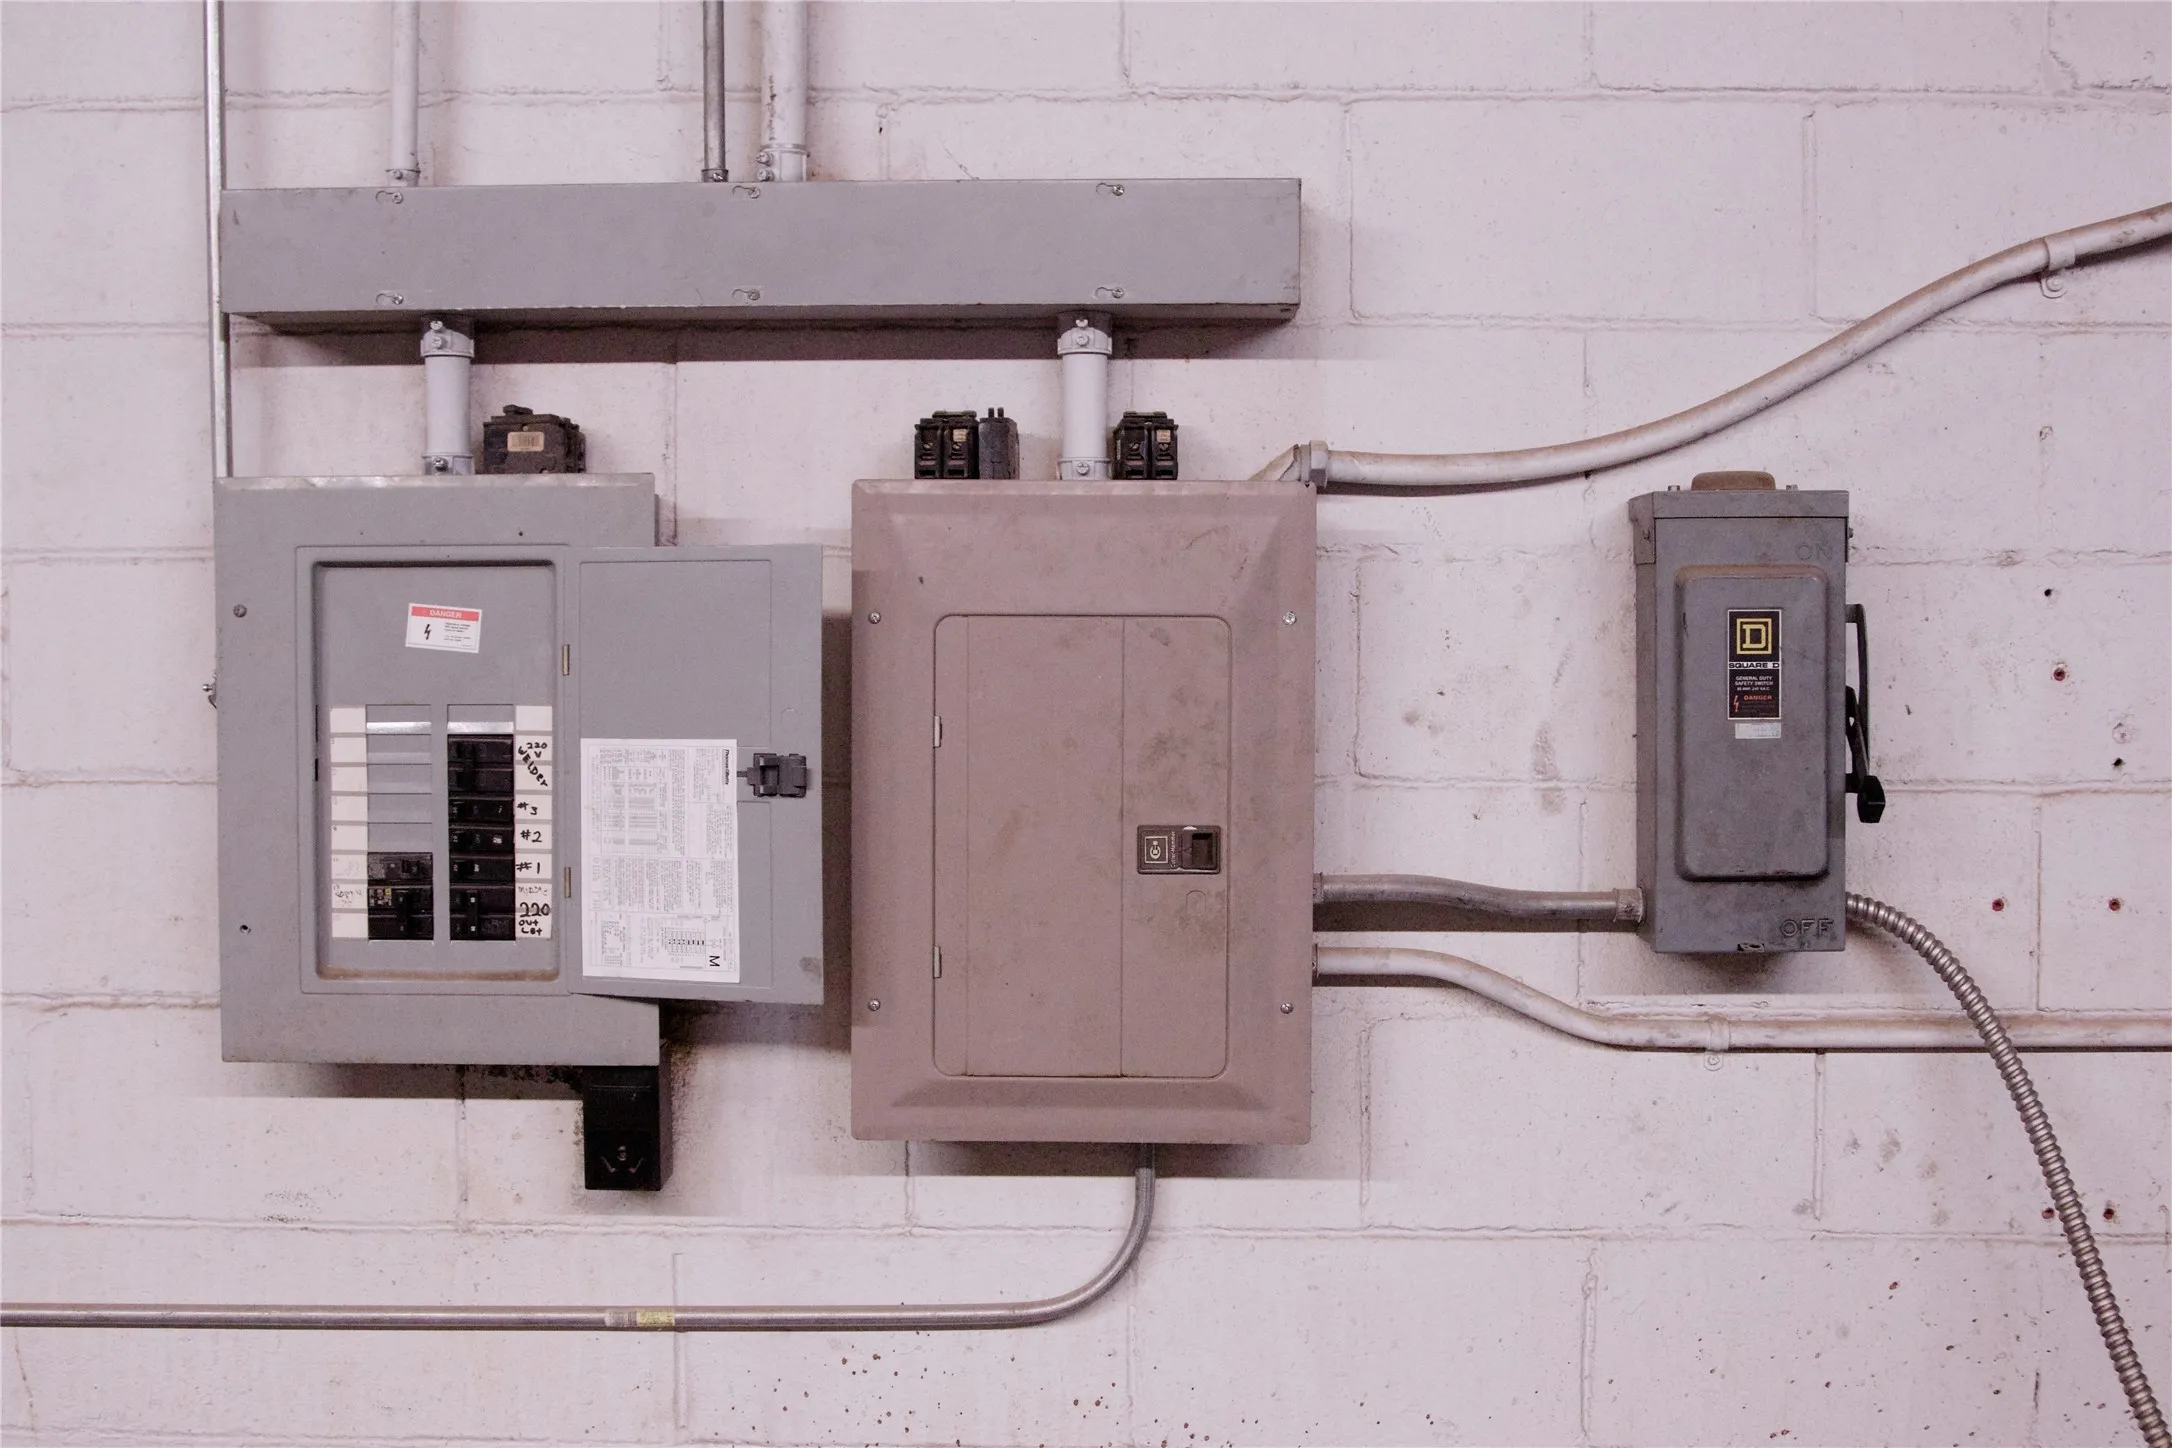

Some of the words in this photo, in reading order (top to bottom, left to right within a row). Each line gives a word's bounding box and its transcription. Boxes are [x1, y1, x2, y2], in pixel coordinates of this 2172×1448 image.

[1795, 542, 1832, 561] ON
[429, 609, 462, 618] DANGER
[1742, 624, 1766, 649] D
[517, 802, 538, 815] #3
[520, 829, 543, 843] #2
[516, 862, 541, 874] #1
[520, 902, 551, 917] 220
[1780, 918, 1834, 939] OFF
